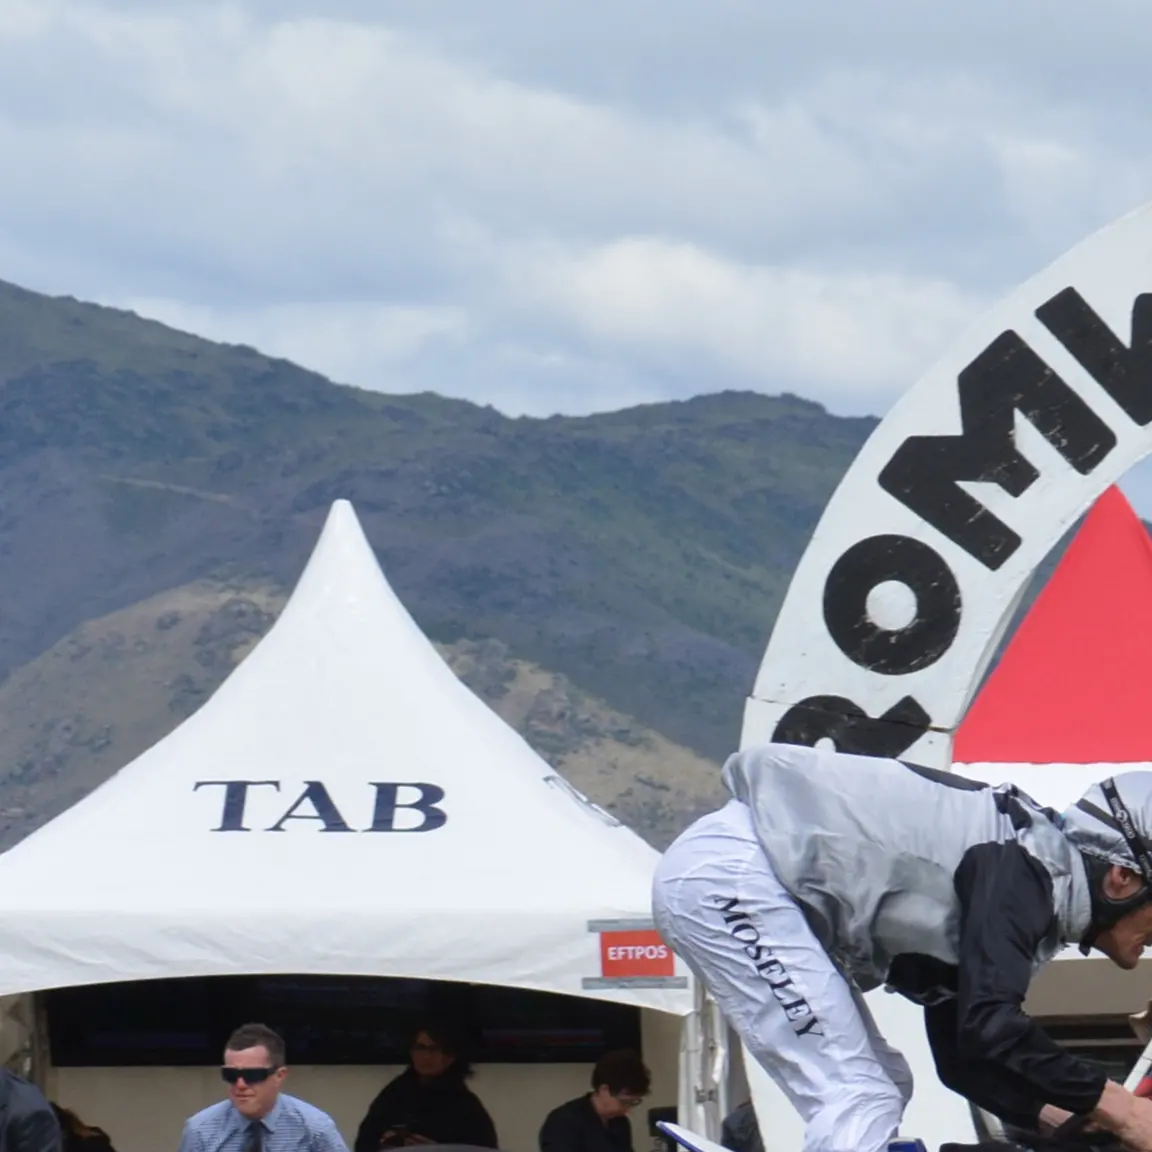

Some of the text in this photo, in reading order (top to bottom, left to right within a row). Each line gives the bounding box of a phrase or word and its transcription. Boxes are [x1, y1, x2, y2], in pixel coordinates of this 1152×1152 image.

[192, 780, 448, 832] TAB
[607, 944, 668, 961] EFTPOS
[713, 894, 825, 1038] MOSELEY
